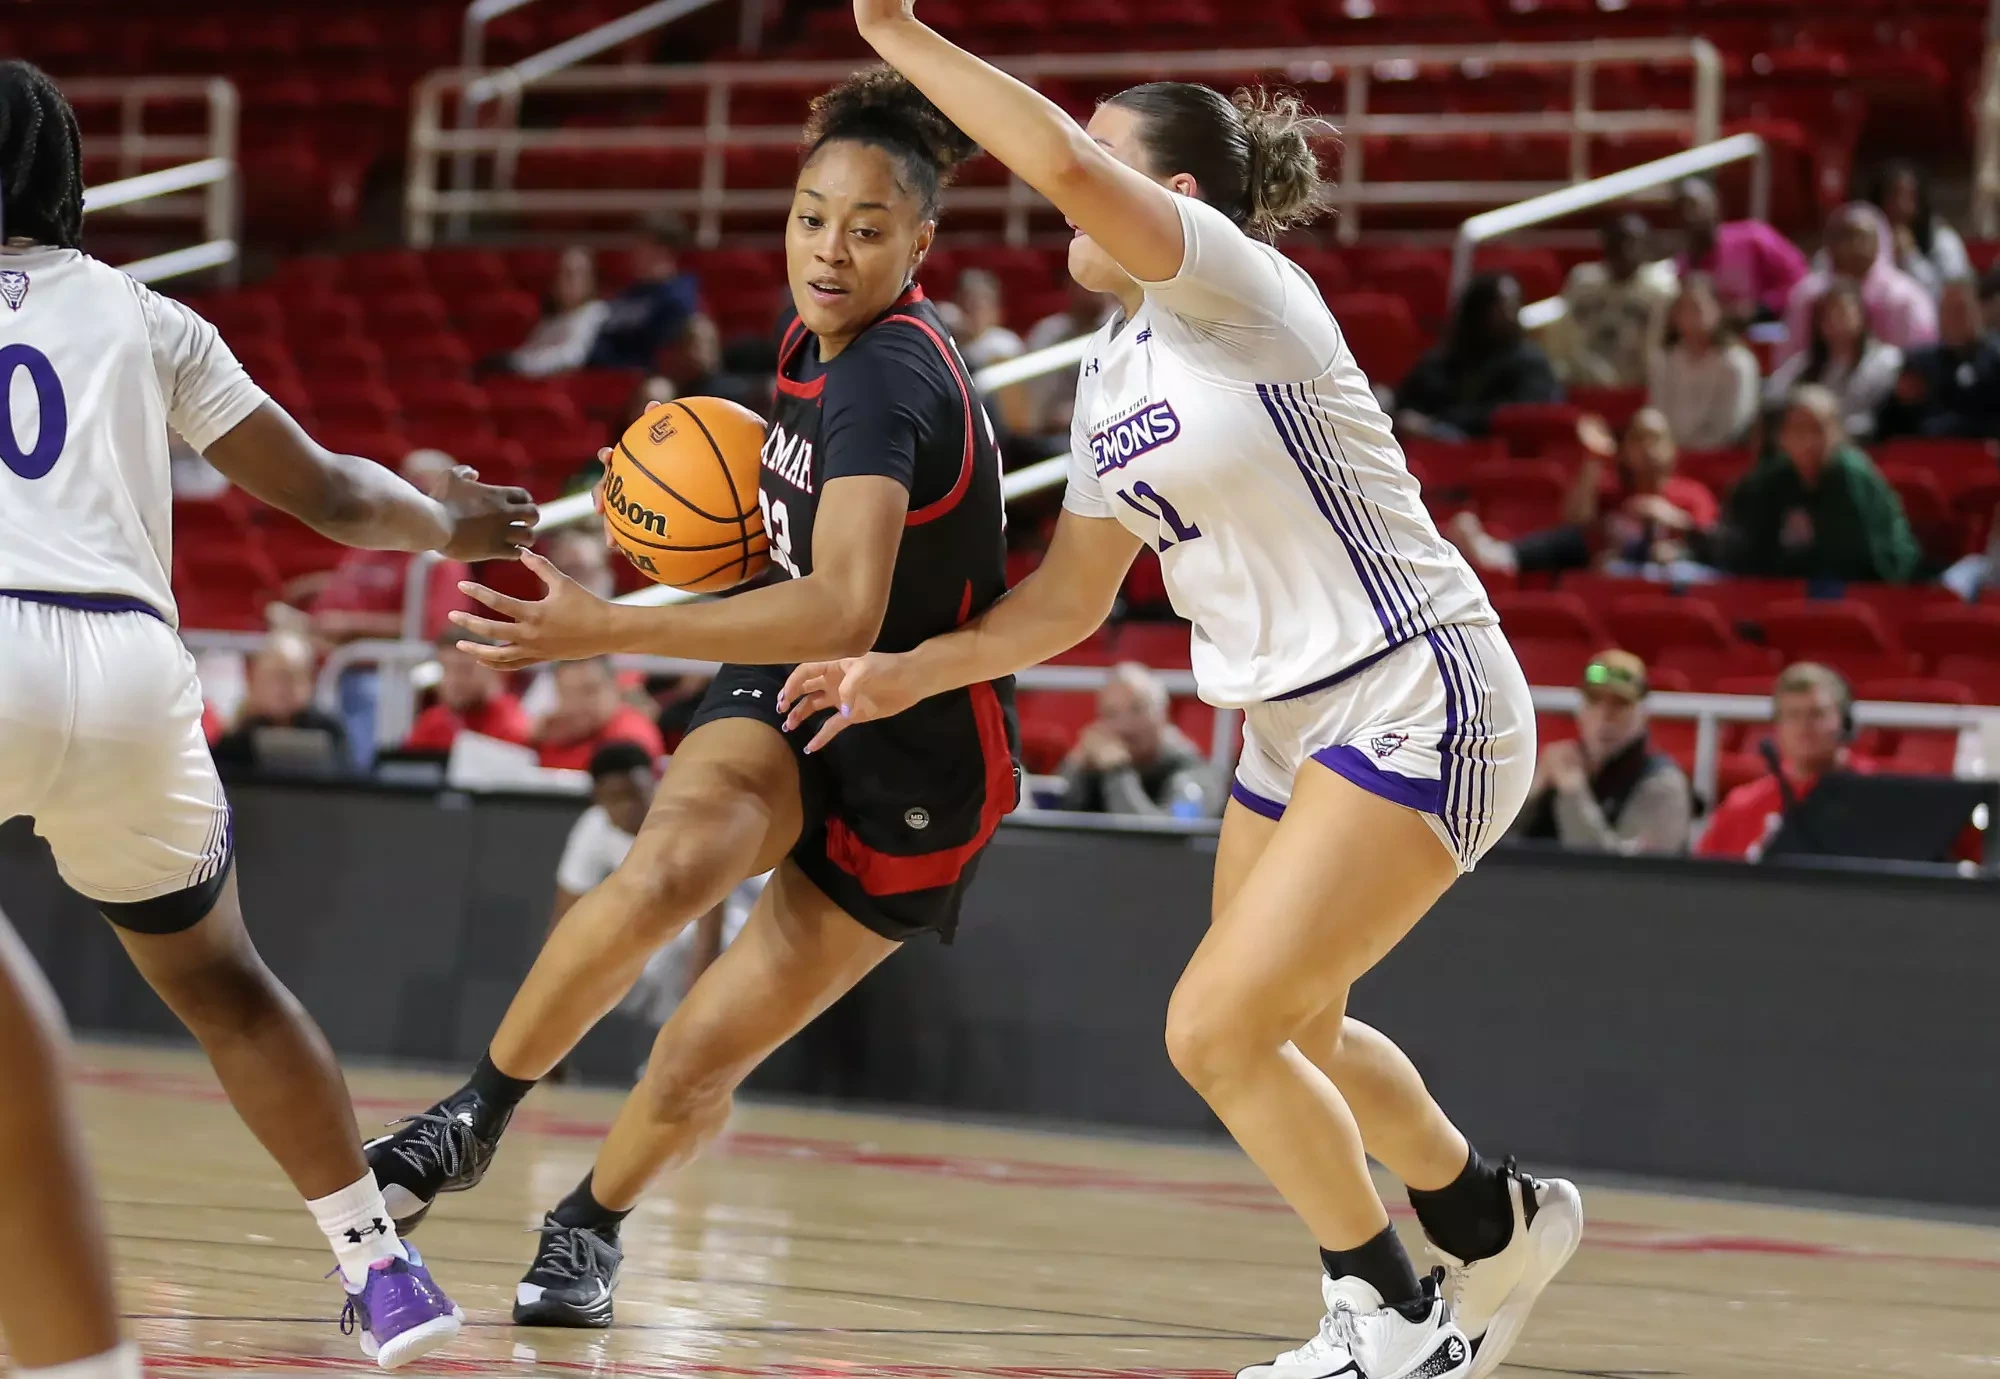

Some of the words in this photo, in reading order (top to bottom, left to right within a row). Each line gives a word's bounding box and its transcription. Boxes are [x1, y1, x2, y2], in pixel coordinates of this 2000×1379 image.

[1091, 404, 1176, 472] EMONS
[1129, 394, 1148, 413] STATE
[760, 421, 814, 494] AMAR
[1116, 480, 1202, 553] 12
